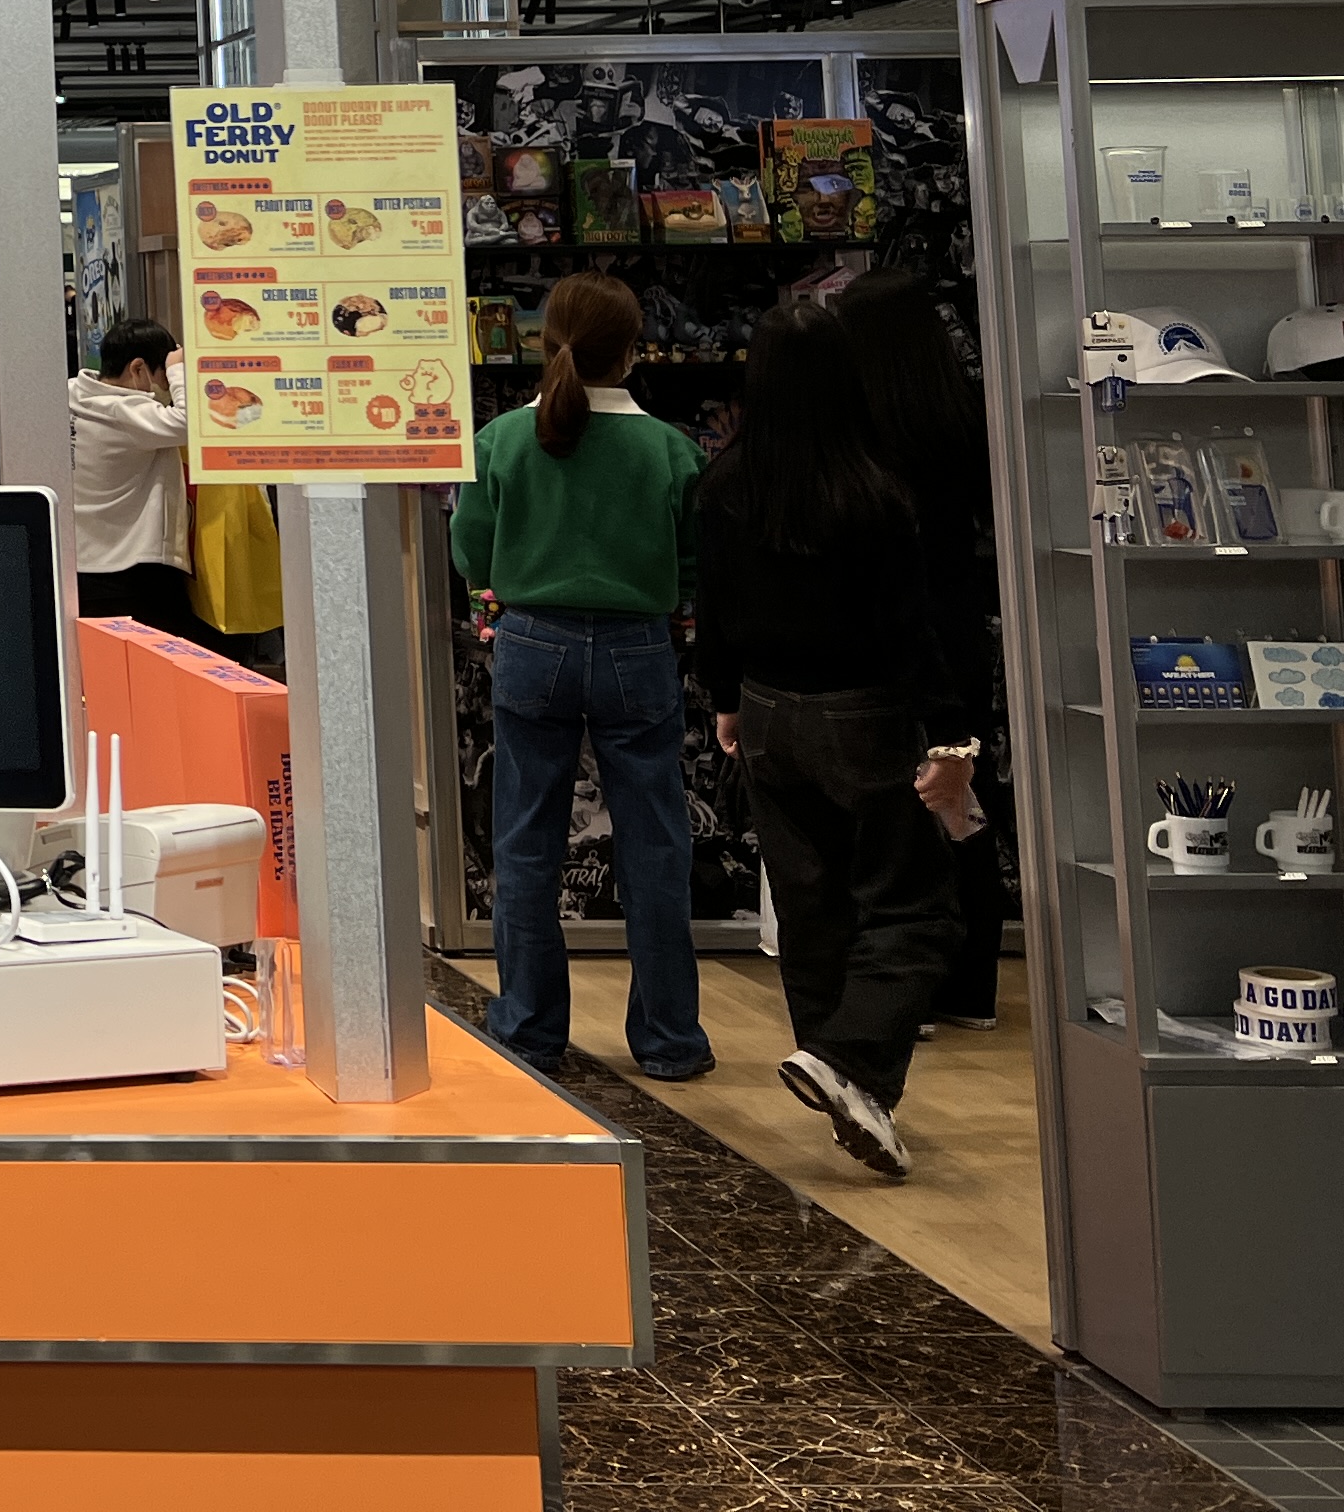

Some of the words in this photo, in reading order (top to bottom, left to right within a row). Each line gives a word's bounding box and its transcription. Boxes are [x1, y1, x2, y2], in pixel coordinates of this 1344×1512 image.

[206, 102, 273, 123] OLD
[185, 119, 295, 148] FERRY
[204, 149, 279, 164] DONUT
[267, 779, 281, 807] BE
[562, 864, 610, 897] XTRA!
[1246, 982, 1257, 1004] A
[1258, 1019, 1317, 1042] DAY!
